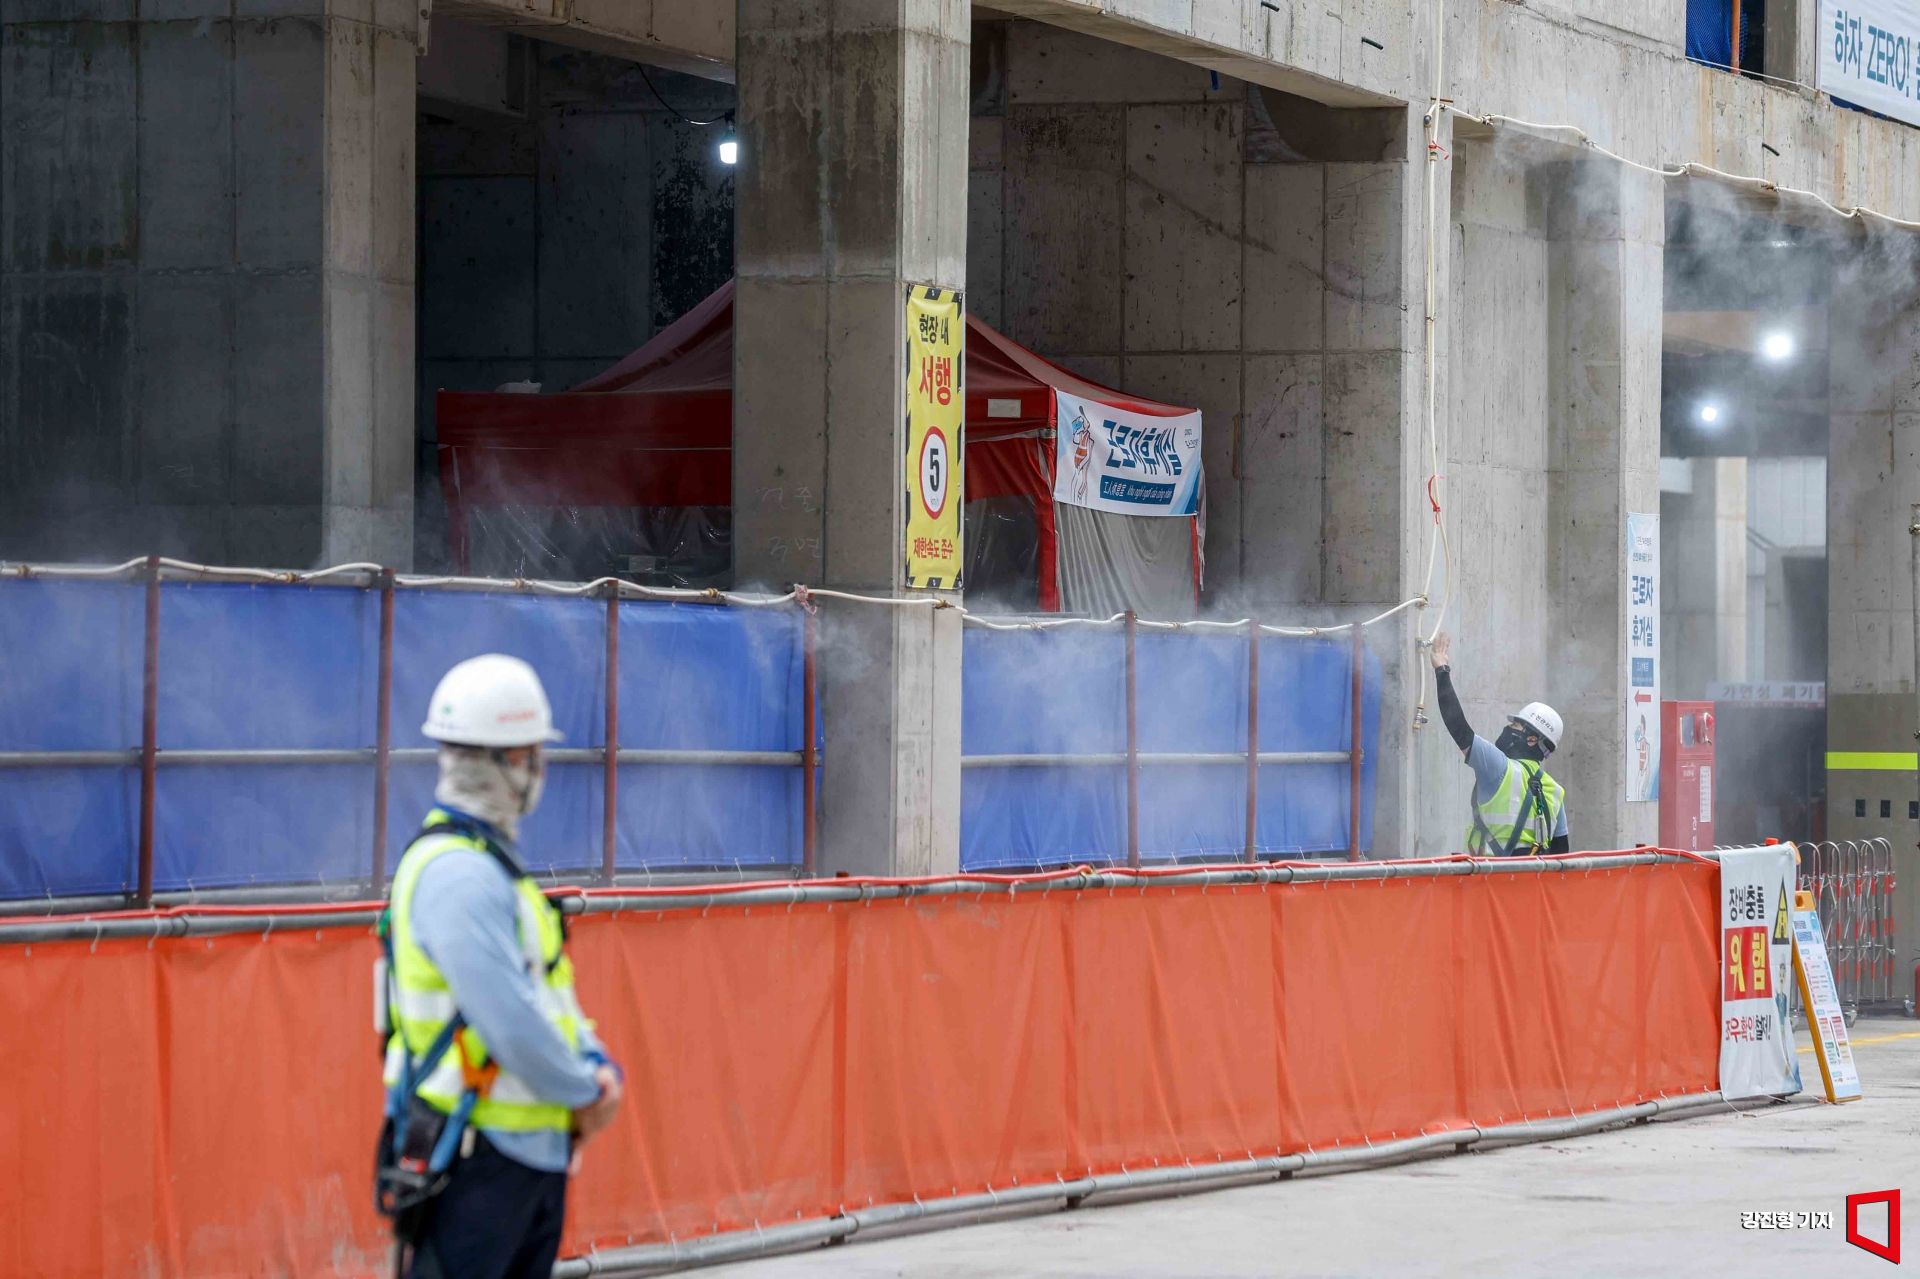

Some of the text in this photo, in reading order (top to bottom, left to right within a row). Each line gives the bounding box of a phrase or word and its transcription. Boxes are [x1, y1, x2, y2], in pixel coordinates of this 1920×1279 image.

[1835, 10, 1862, 79] 하자
[1867, 25, 1910, 98] ZERO!
[919, 313, 949, 346] 현장 내
[919, 355, 951, 405] 서행
[929, 448, 940, 492] 5
[913, 537, 954, 560] 제한속도 준수
[1632, 575, 1654, 607] 근로자
[1632, 614, 1653, 648] 휴게실
[1729, 931, 1766, 993] 위험
